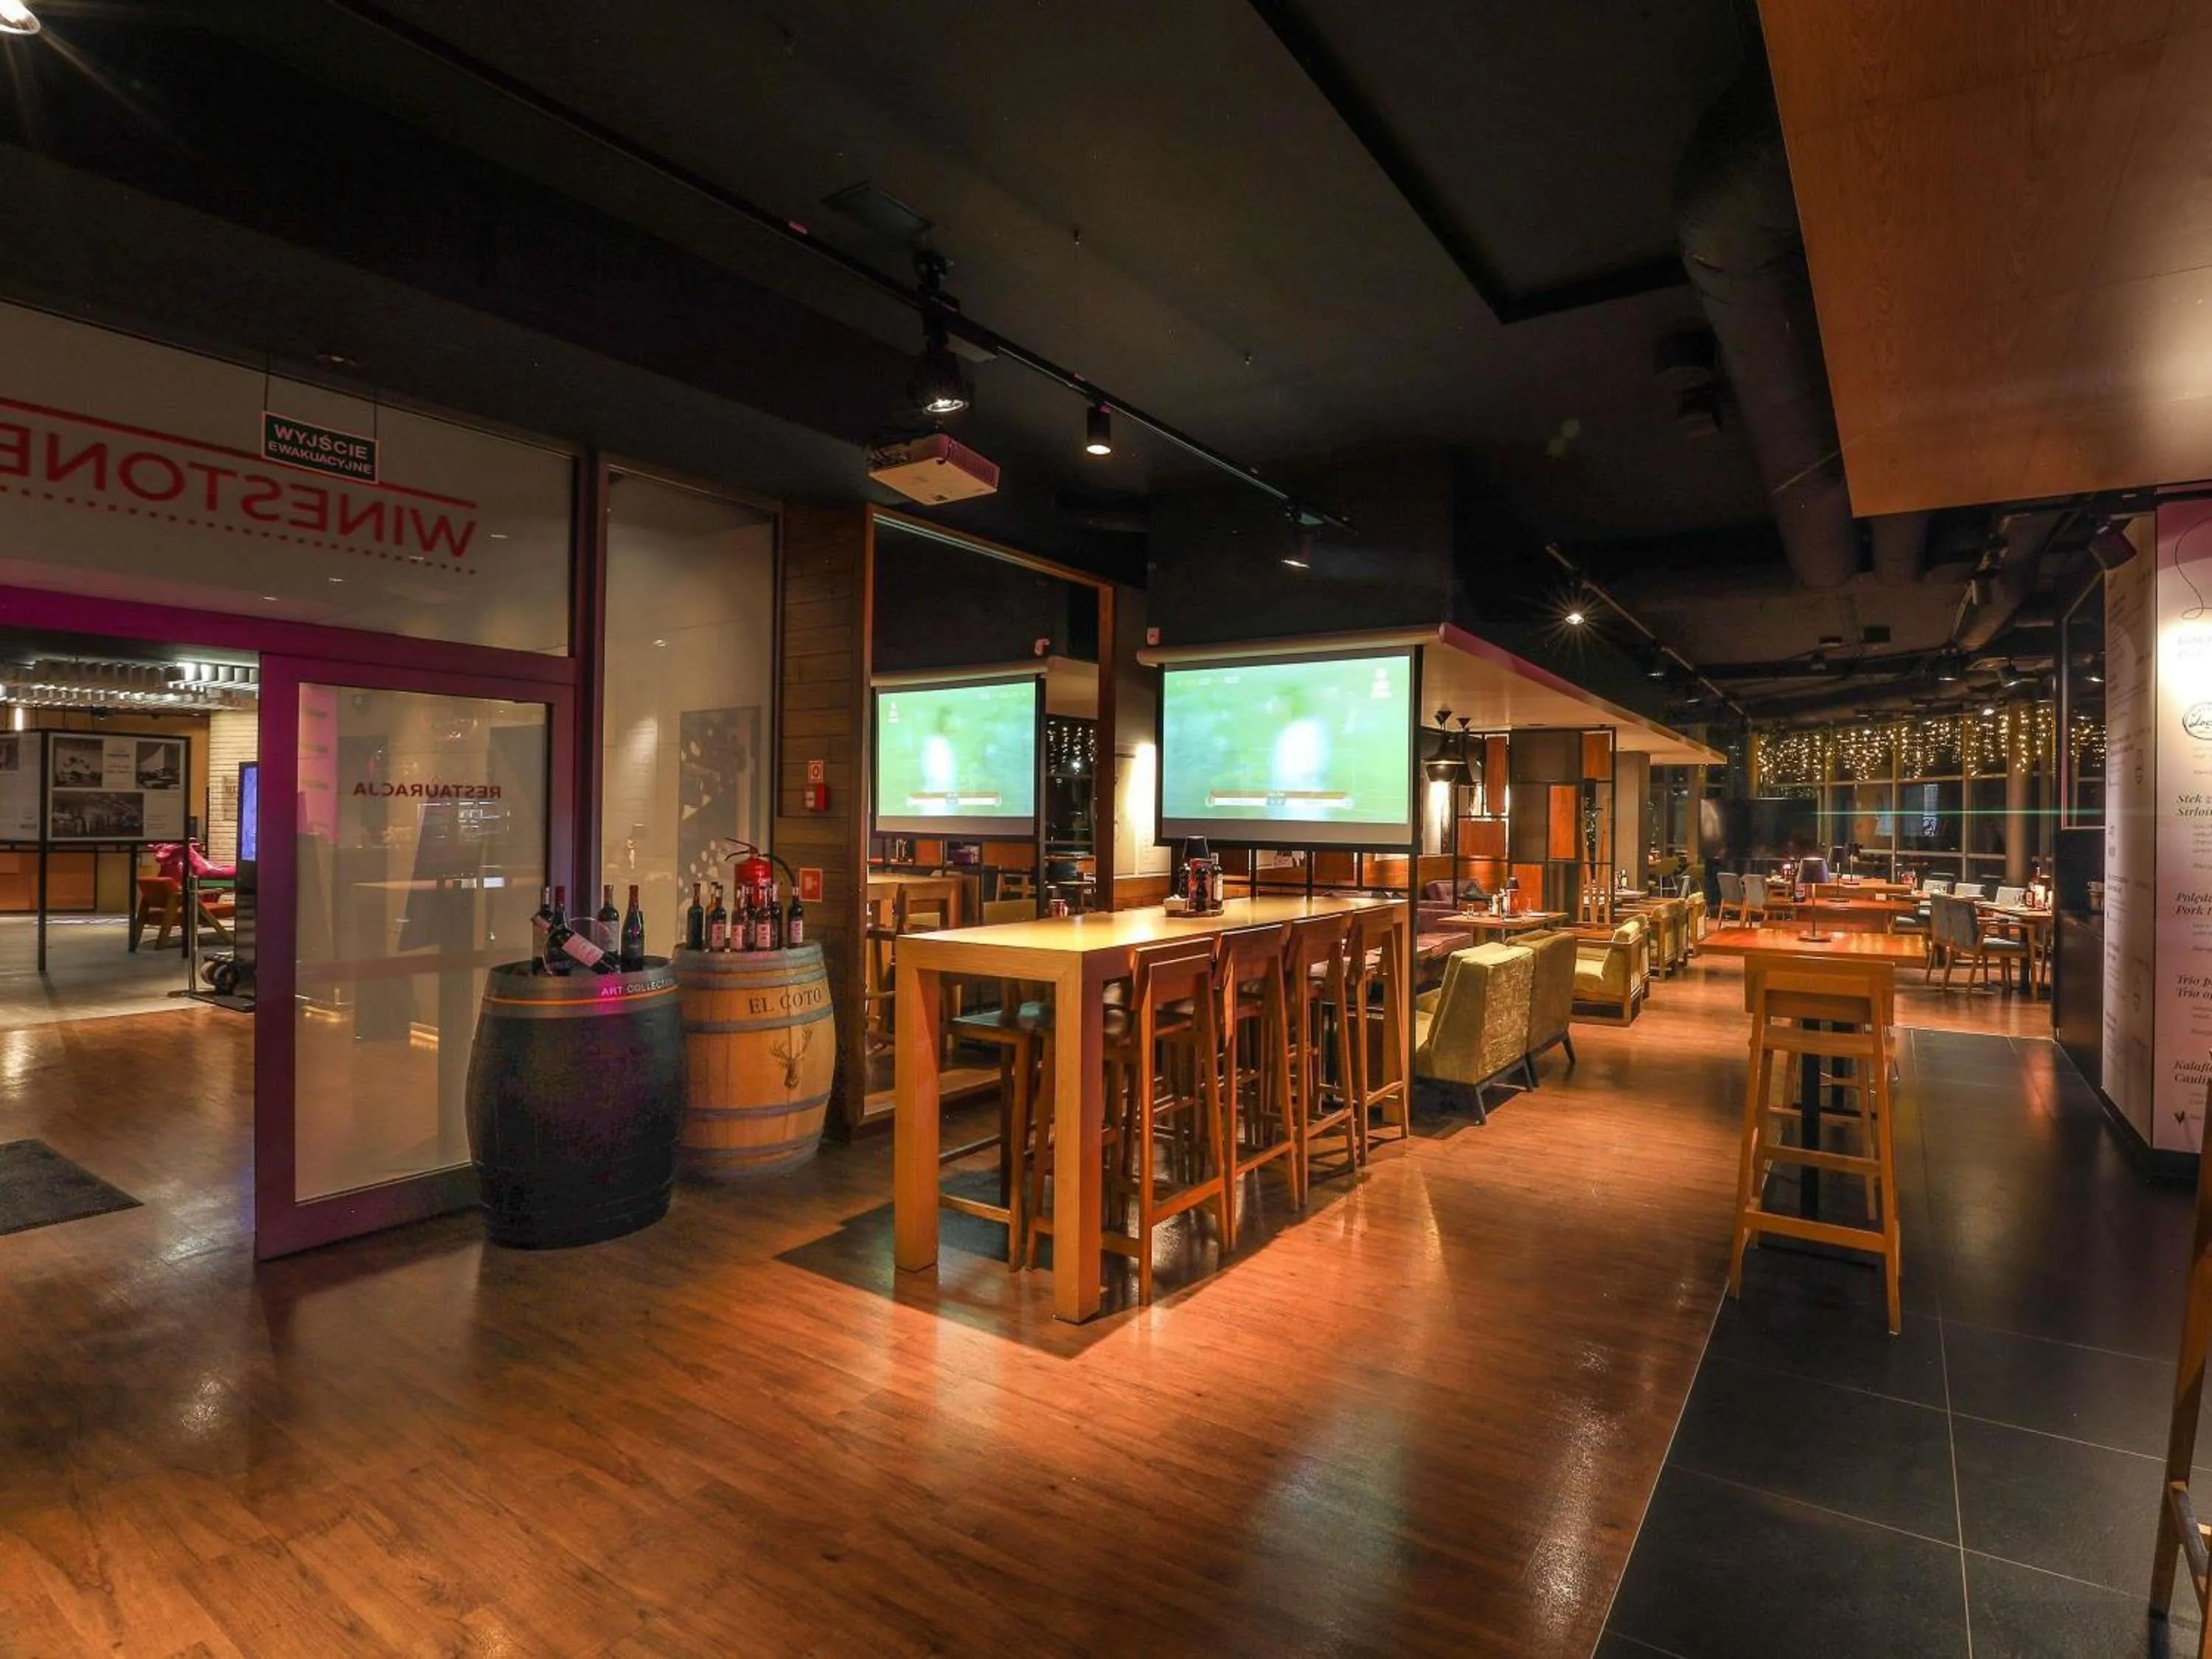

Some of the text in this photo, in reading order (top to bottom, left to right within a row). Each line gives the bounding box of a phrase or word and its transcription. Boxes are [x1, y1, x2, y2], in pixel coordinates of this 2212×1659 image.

[274, 424, 367, 459] WYJŚCIE
[268, 440, 373, 474] EWAKUACYJNE
[2176, 794, 2202, 803] Stek
[2175, 905, 2203, 915] Pork
[601, 986, 623, 998] ART
[748, 988, 822, 1015] EL COTO
